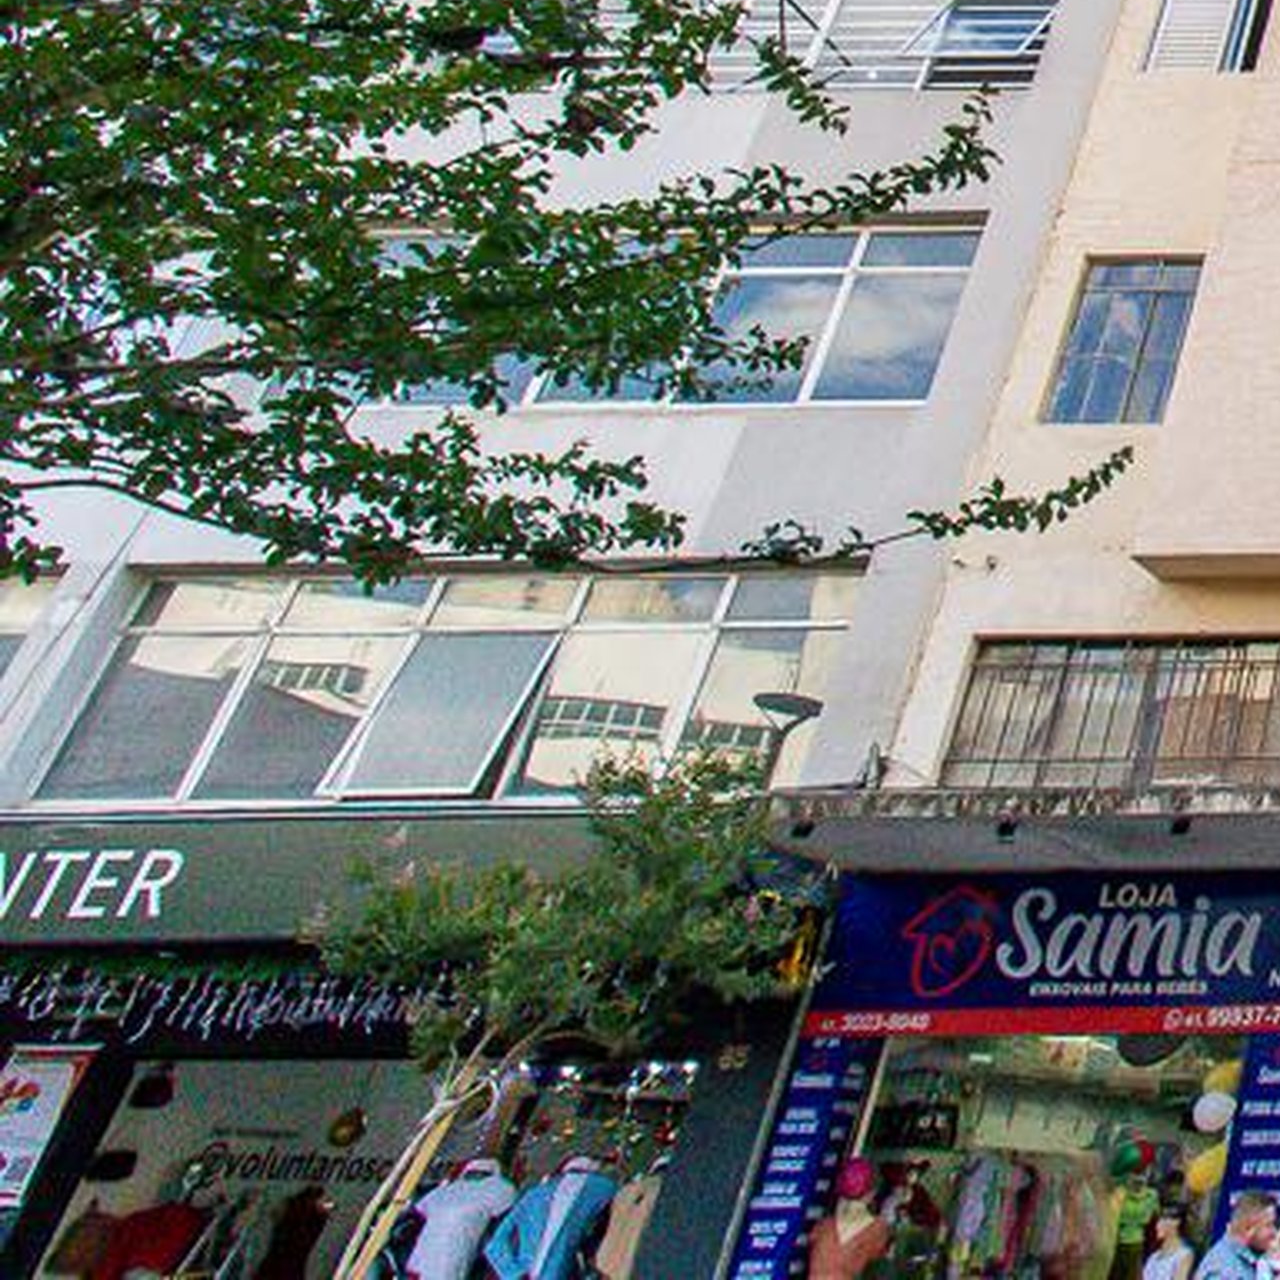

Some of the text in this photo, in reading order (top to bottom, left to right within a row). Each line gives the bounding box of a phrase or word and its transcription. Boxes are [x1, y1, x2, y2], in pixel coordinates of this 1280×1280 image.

[1099, 883, 1177, 908] LOJA
[995, 887, 1262, 979] Samia
[1110, 981, 1152, 996] PARA
